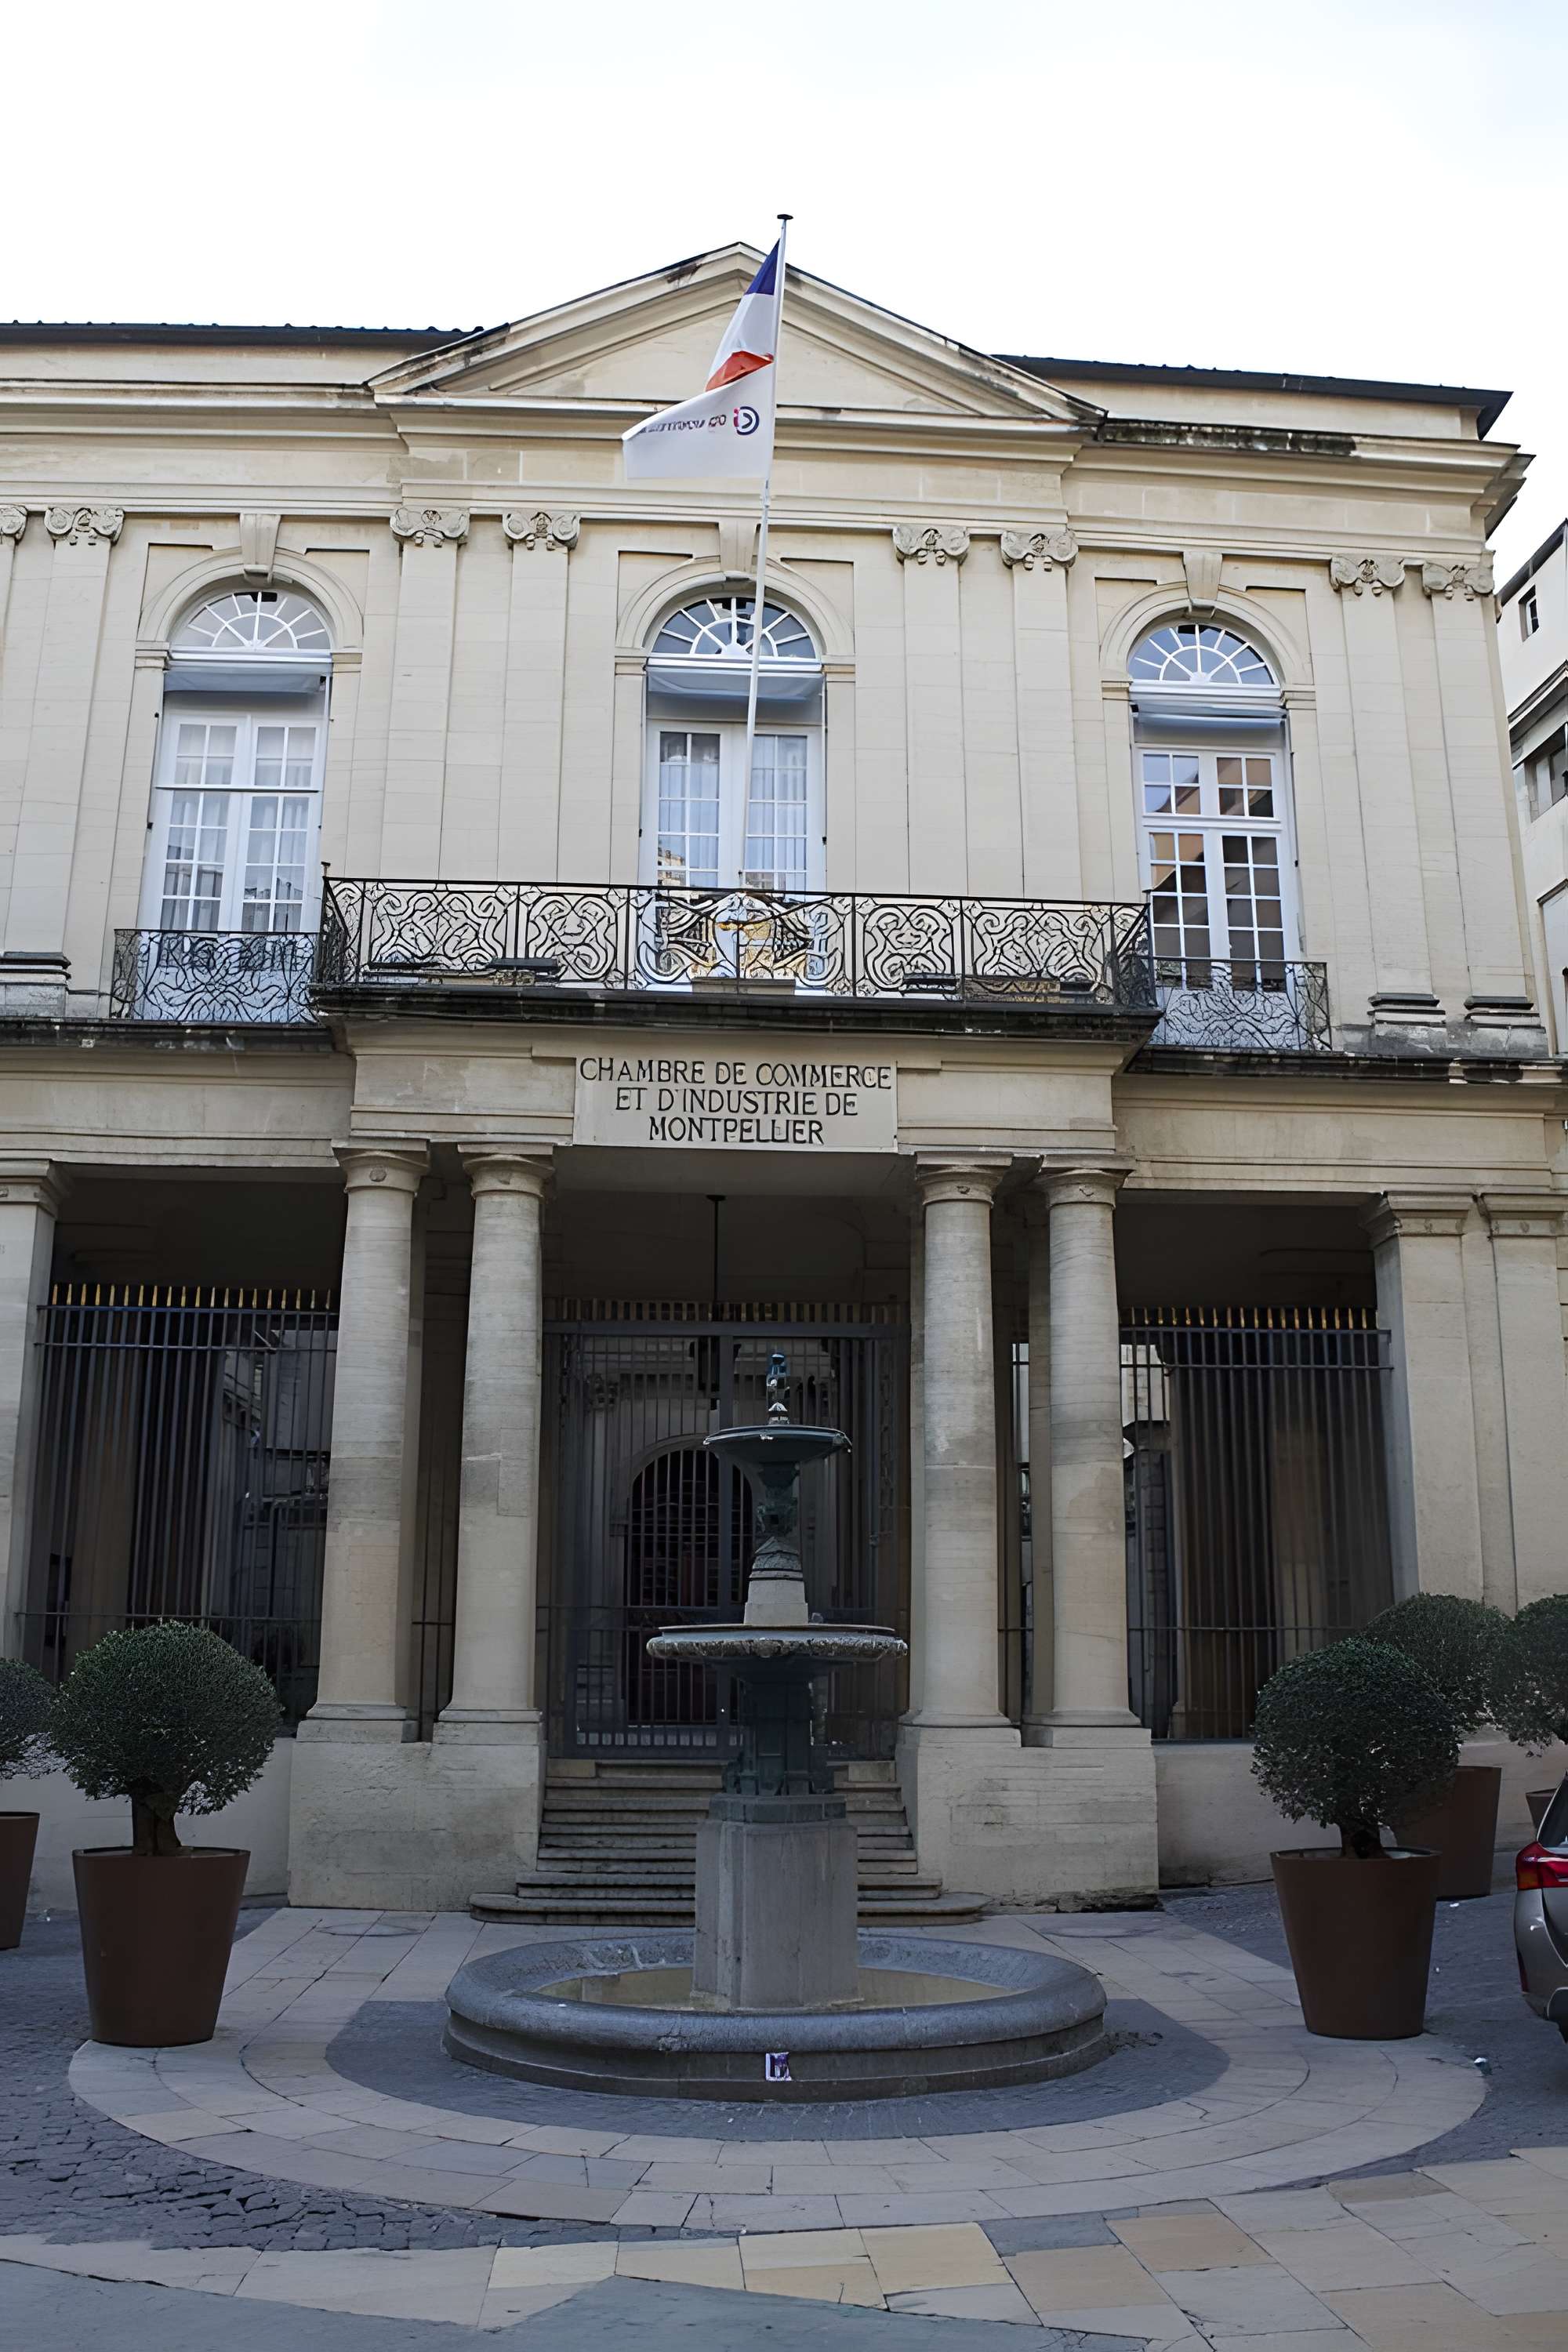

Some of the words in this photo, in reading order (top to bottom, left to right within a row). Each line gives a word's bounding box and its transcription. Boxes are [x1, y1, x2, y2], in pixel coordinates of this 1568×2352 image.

[580, 1058, 705, 1083] CHAMBRE
[716, 1062, 747, 1084] DE
[756, 1062, 891, 1090] COMMERCE
[615, 1087, 648, 1110] ET
[658, 1087, 817, 1115] D'INDUSTRIE
[826, 1092, 858, 1116] DE
[648, 1116, 825, 1145] MONTPELLIER
